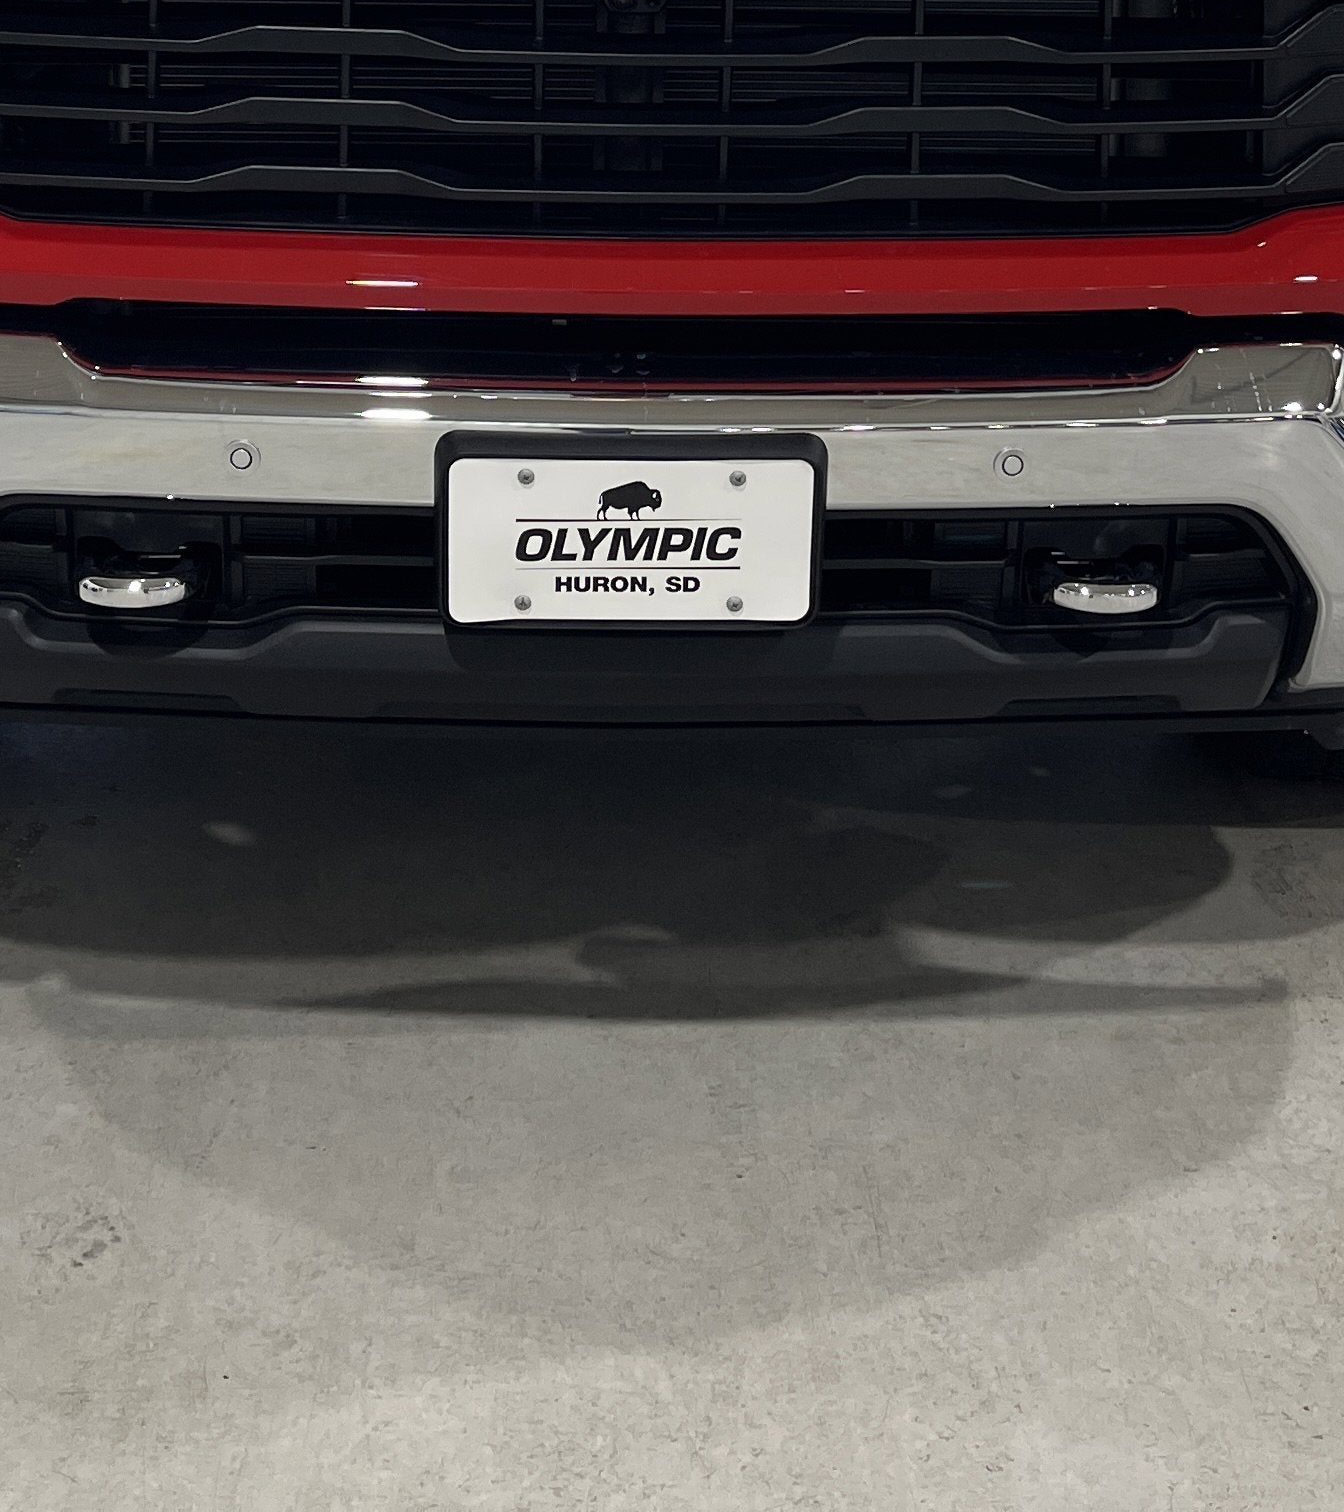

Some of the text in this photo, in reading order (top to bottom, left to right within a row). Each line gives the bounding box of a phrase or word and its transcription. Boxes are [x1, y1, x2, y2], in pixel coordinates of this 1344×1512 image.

[514, 525, 743, 562] OLYMPIC
[554, 575, 701, 596] HURON, SD
